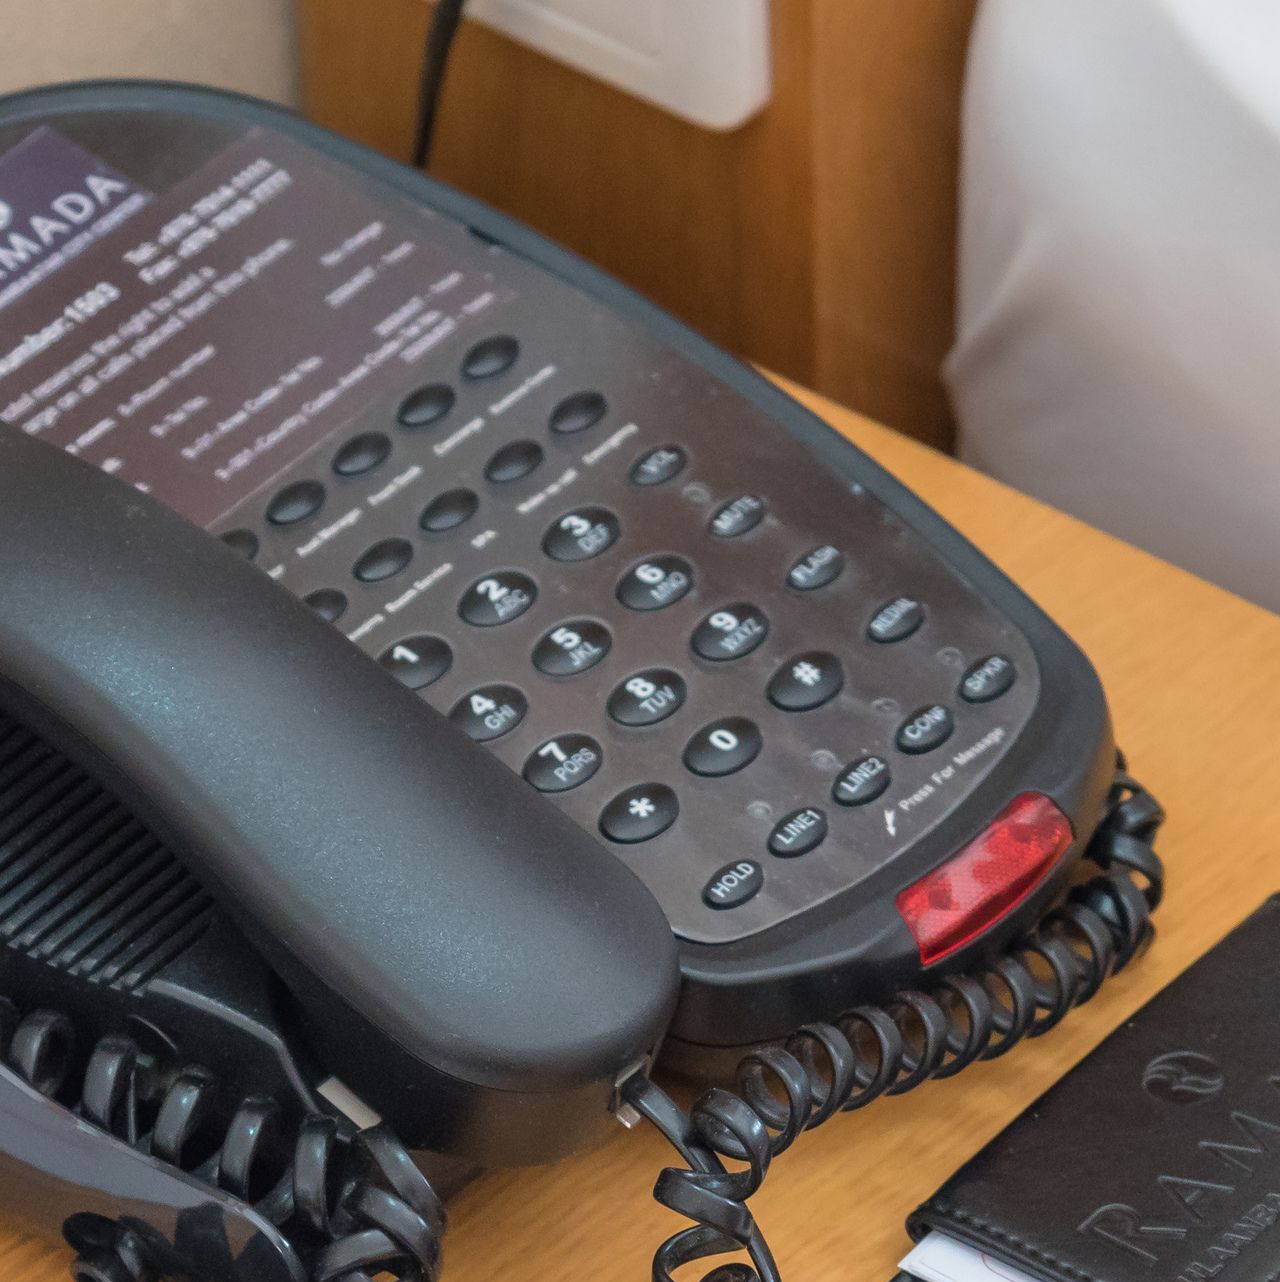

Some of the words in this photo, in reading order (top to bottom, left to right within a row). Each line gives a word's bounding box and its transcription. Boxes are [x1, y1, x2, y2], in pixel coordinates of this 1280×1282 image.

[560, 515, 590, 535] 3
[713, 496, 759, 533] MUTE
[577, 523, 608, 552] DEF
[636, 564, 664, 582] 6
[791, 545, 839, 582] FLASH
[476, 579, 508, 601] 2
[649, 571, 687, 602] MNO
[494, 588, 529, 619] ABC
[870, 598, 917, 634] REDIAL
[708, 612, 737, 630] 9
[719, 617, 763, 652] WXYZ
[550, 627, 580, 648] 5
[392, 645, 418, 662] 1
[569, 641, 602, 668] JKL
[625, 678, 656, 697] 8
[793, 661, 820, 686] #
[965, 656, 1007, 695] SPKR
[470, 694, 496, 715] 4
[639, 685, 675, 713] TUV
[484, 704, 516, 730] GHI
[904, 706, 945, 741] CONF
[538, 741, 566, 761] 7
[709, 729, 738, 750] 0
[553, 747, 597, 782] PQRS
[840, 757, 885, 795] LINE2
[898, 783, 936, 812] Press
[931, 765, 956, 785] For
[952, 727, 1005, 767] Message
[775, 809, 820, 847] LINE1
[710, 862, 754, 900] HOLD
